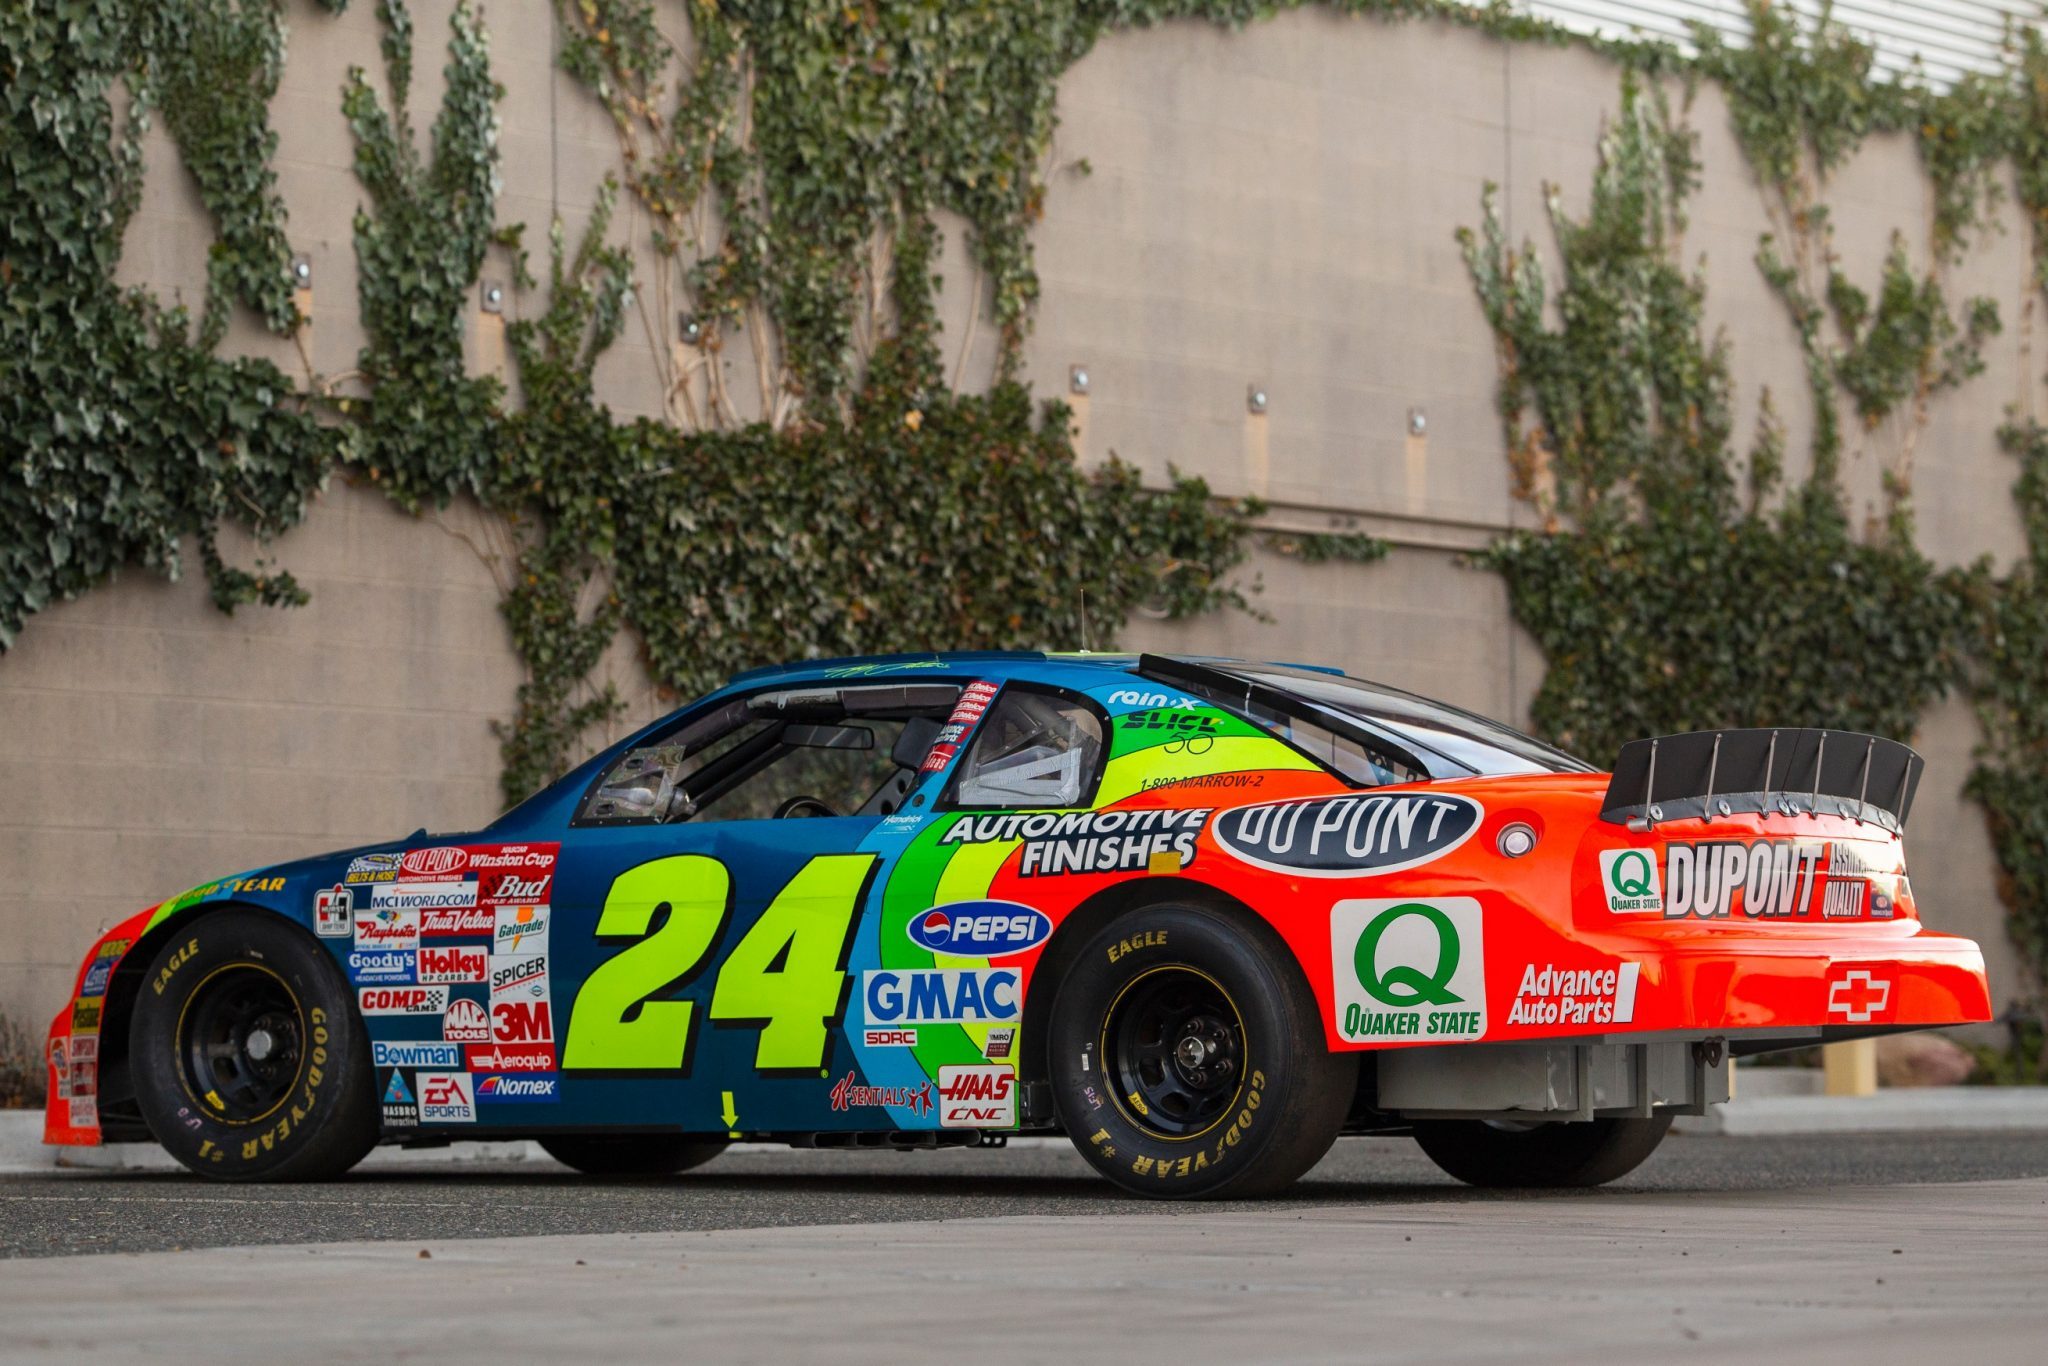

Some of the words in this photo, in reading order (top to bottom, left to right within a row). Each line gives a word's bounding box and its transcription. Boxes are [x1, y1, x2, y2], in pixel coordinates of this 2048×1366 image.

[1121, 711, 1217, 733] SLICK
[1164, 732, 1214, 754] 50
[1141, 775, 1264, 793] 1-800-MARROW-2
[944, 807, 1213, 843] AUTOMOTIVE
[469, 854, 524, 868] Winston
[524, 853, 554, 868] Cup
[493, 875, 551, 897] Bud
[373, 896, 398, 908] MCI
[401, 894, 476, 907] WORLDCOM
[1611, 896, 1642, 912] QUAKER
[1642, 897, 1661, 910] STATE
[1822, 881, 1865, 919] QUALITY
[356, 921, 417, 943] Raybestos
[499, 920, 544, 938] Gatorade
[952, 916, 1038, 941] PEPSI
[1107, 931, 1168, 963] EAGLE
[153, 939, 199, 995] EAGLE
[349, 952, 415, 974] Goody's
[420, 949, 486, 981] Holley
[493, 956, 545, 987] SPICER
[561, 853, 880, 1071] 24
[1517, 963, 1616, 997] Advance
[362, 990, 427, 1009] COMP
[867, 971, 1019, 1021] GMAC
[405, 1004, 438, 1013] CAMS
[445, 1002, 488, 1028] MAC
[1507, 996, 1558, 1026] Auto
[1559, 996, 1613, 1025] Parts
[493, 1002, 551, 1041] 3M
[1344, 1002, 1420, 1039] QUAKER
[1426, 1011, 1480, 1034] STATE
[446, 1030, 488, 1039] TOOLS
[866, 1031, 916, 1044] SDRC
[374, 1043, 458, 1065] Bowman
[492, 1046, 551, 1070] Aeroquip
[424, 1078, 469, 1105] EA
[496, 1078, 555, 1095] Nomex
[946, 1073, 1015, 1101] HAAS
[383, 1105, 417, 1117] HASBRO
[384, 1116, 418, 1127] Interactive
[424, 1105, 470, 1117] SPORTS
[947, 1105, 1006, 1121] CNC
